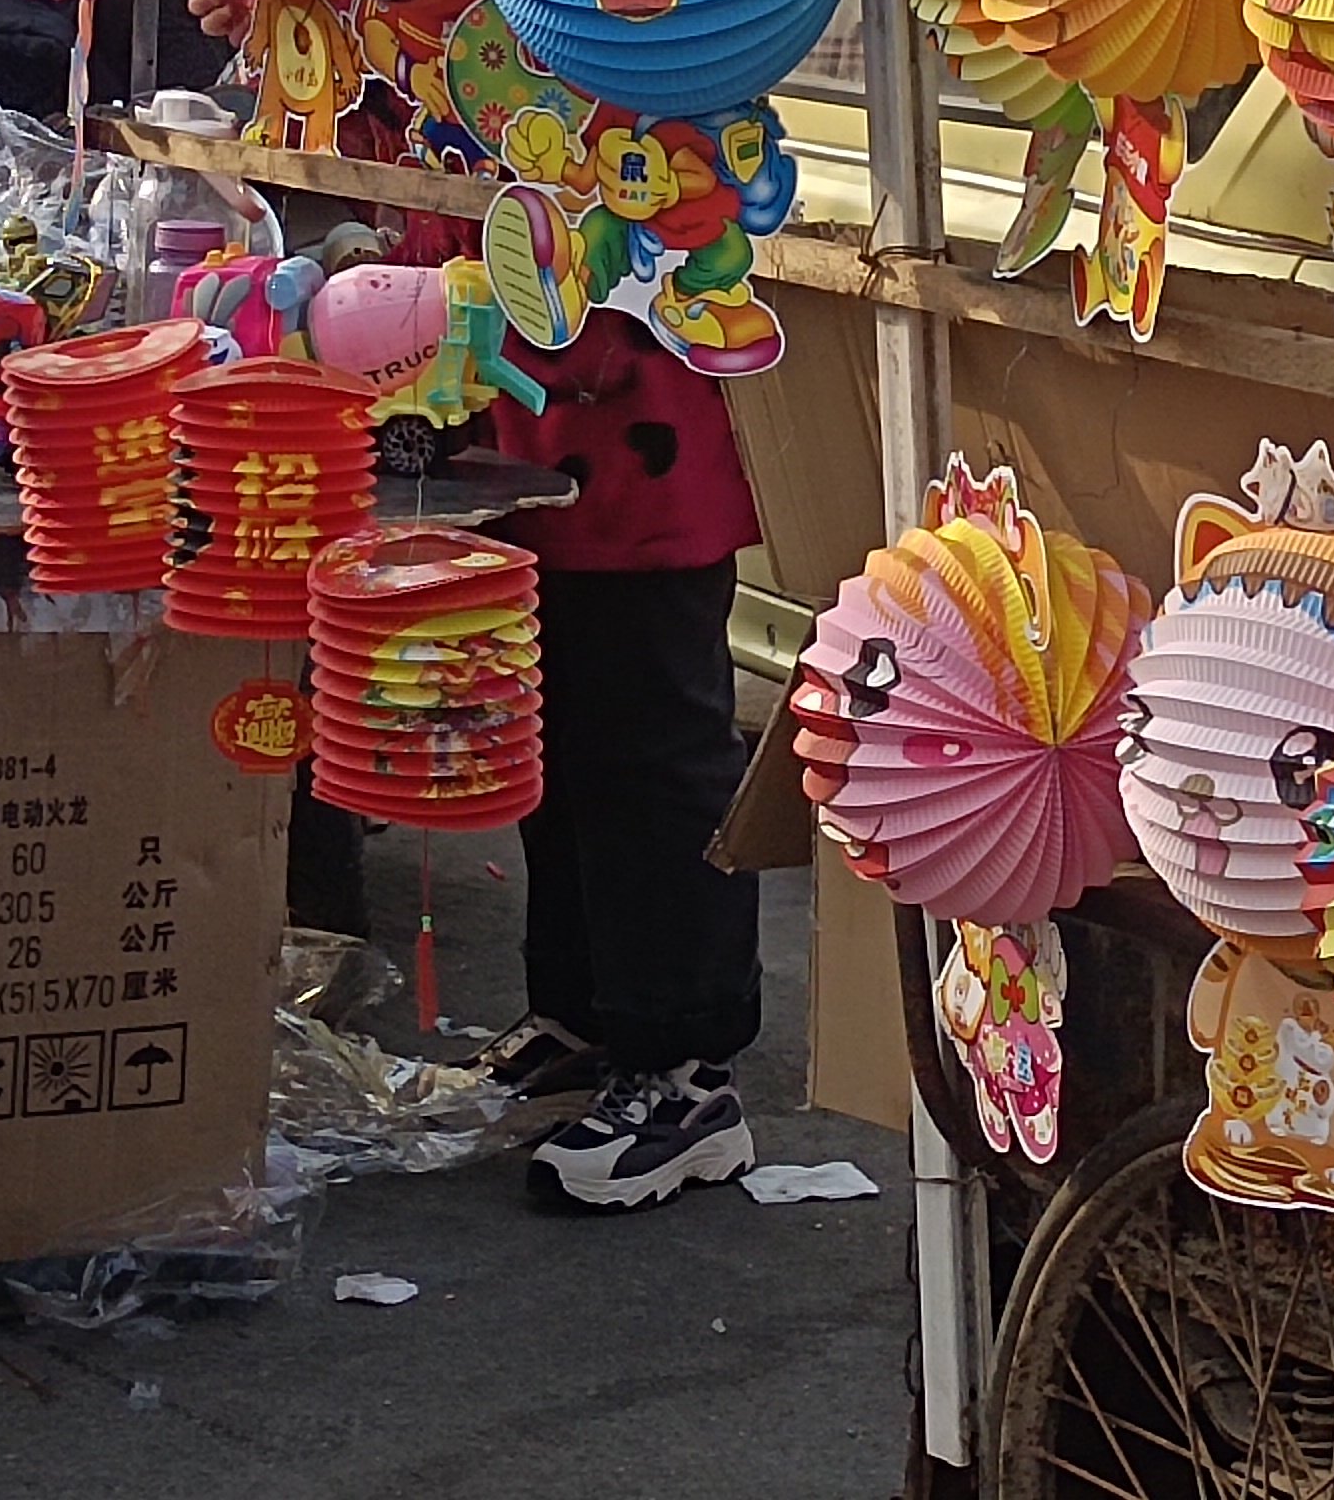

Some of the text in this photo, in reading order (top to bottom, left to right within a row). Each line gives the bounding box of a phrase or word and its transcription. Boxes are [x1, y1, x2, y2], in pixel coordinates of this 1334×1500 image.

[362, 344, 440, 386] TRUC
[12, 841, 46, 877] 60
[137, 835, 162, 867] 只
[122, 878, 178, 910] 公斤
[7, 921, 176, 970] 26 公斤
[121, 967, 178, 1001] 厘米
